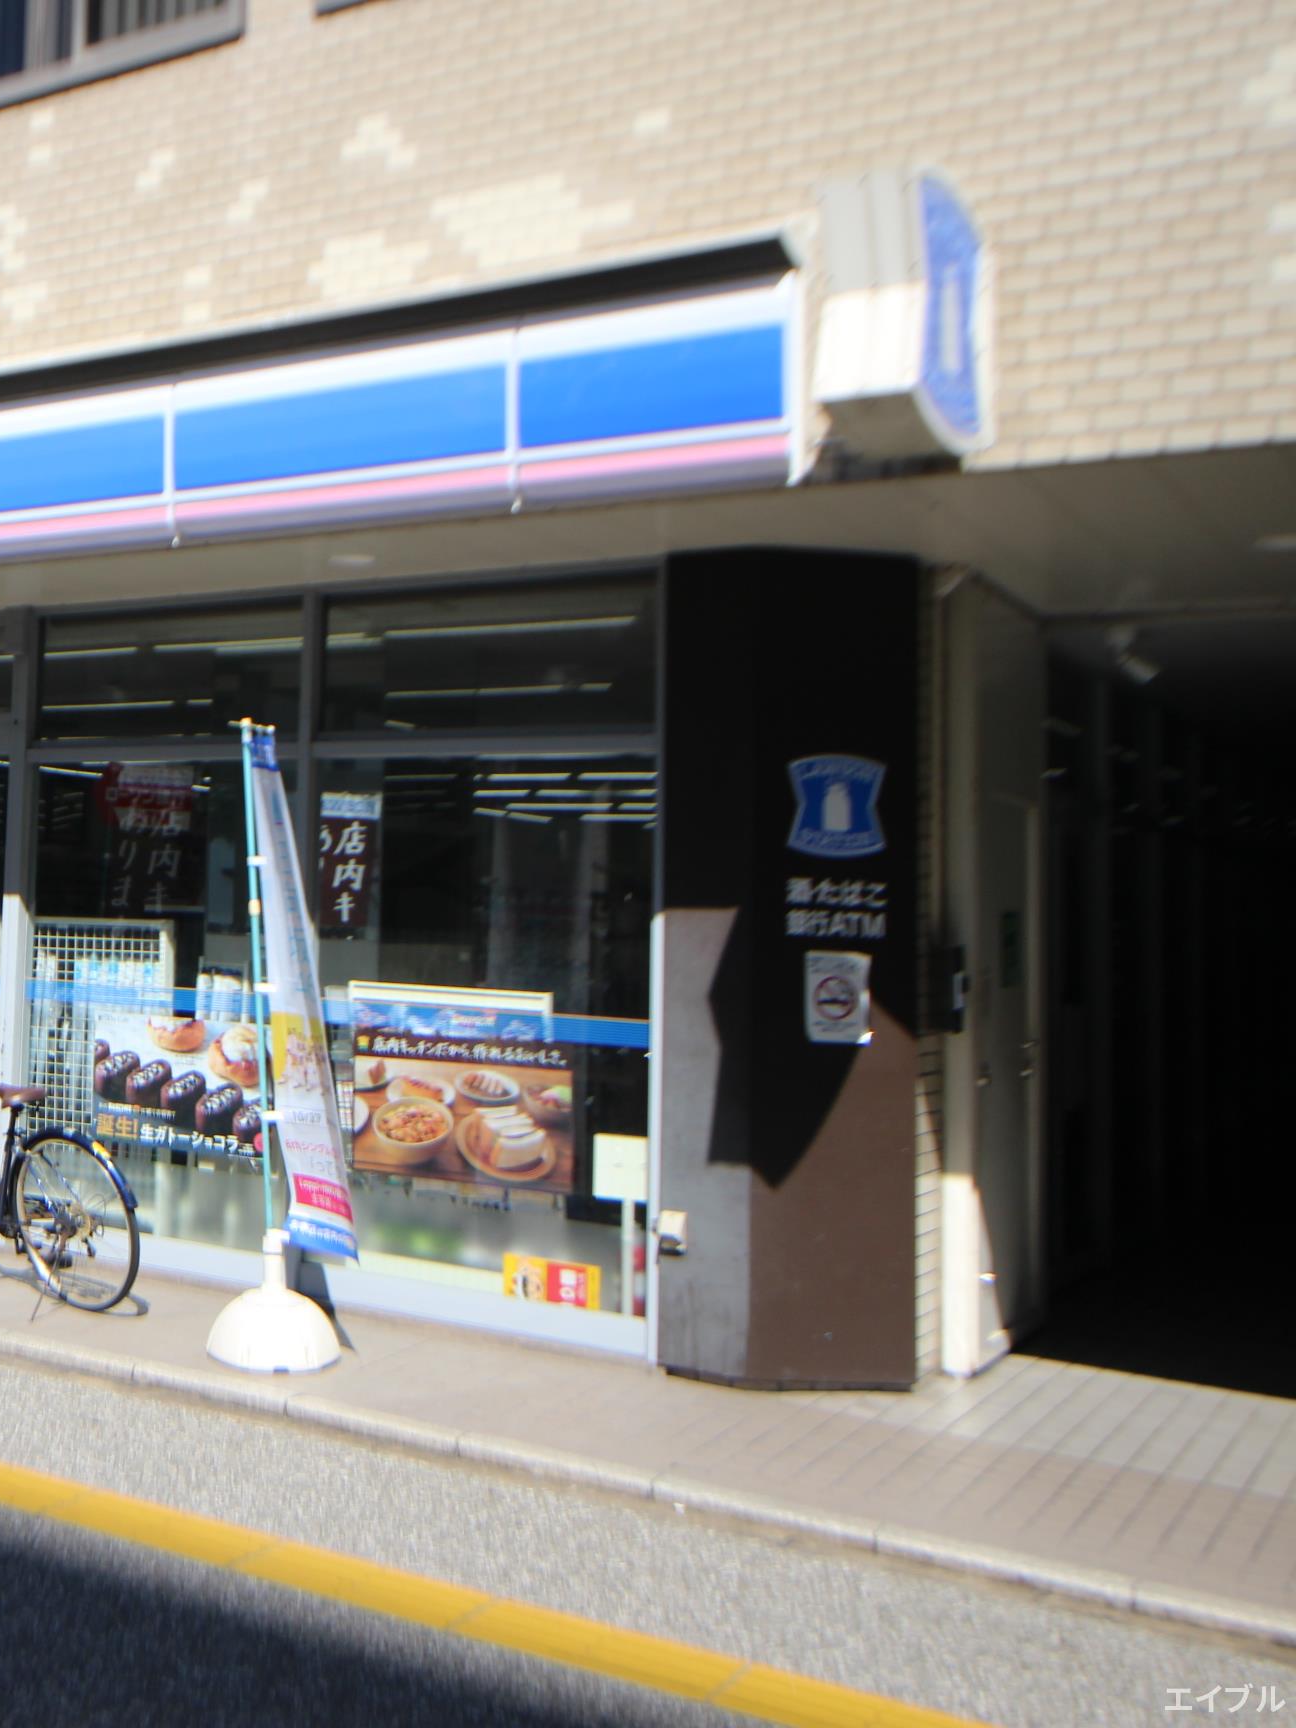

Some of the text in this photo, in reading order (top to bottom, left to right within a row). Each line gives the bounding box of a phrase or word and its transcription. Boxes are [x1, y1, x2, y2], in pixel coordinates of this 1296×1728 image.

[140, 1122, 240, 1152] 生ガトーショコラ
